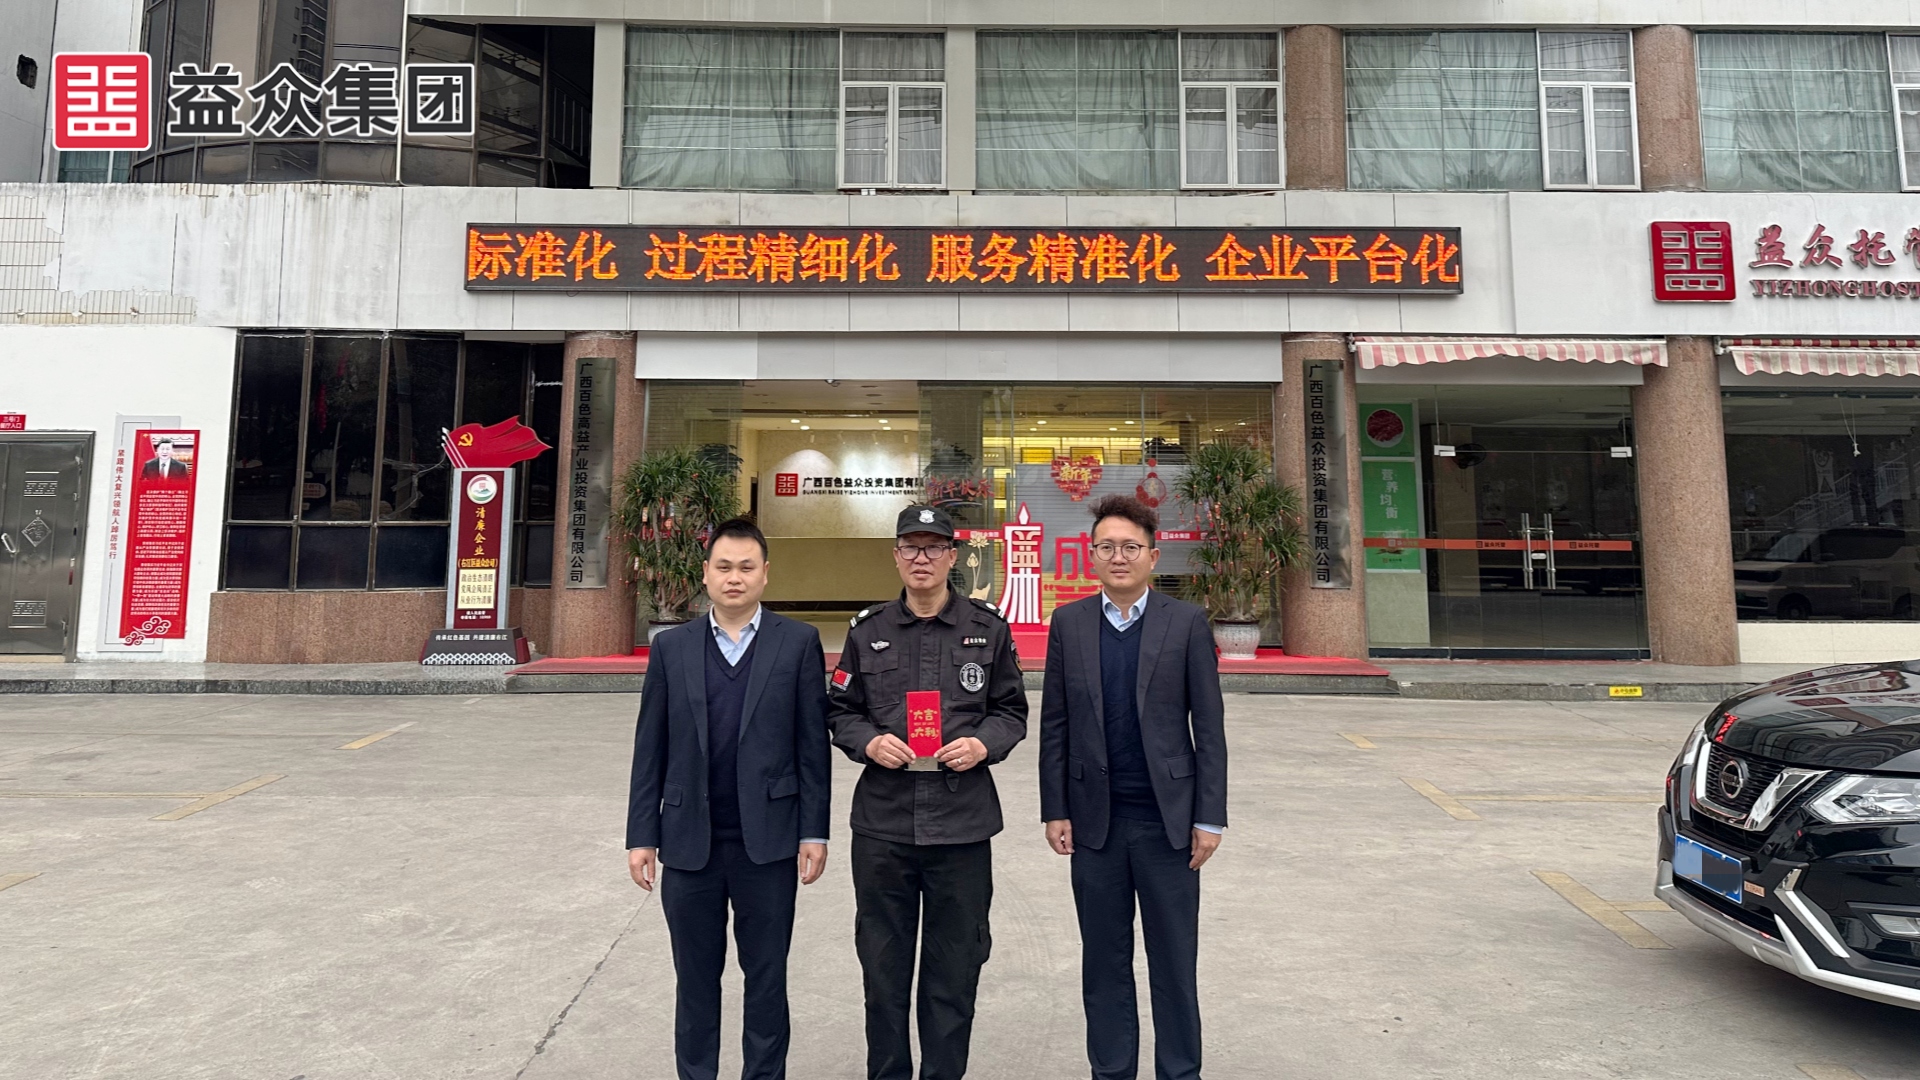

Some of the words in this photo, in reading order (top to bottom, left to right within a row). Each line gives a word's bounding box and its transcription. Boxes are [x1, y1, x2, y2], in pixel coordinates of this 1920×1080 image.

[468, 229, 618, 282] 标准化
[644, 232, 901, 283] 过程精细化
[927, 233, 1180, 284] 服务精准化
[1204, 233, 1459, 284] 企业平台化
[570, 362, 594, 583] 广西百色高益产业投资集团有限公司
[1309, 364, 1331, 583] 广西百色益众投资集团有限公司
[1380, 468, 1398, 519] 营养均衡
